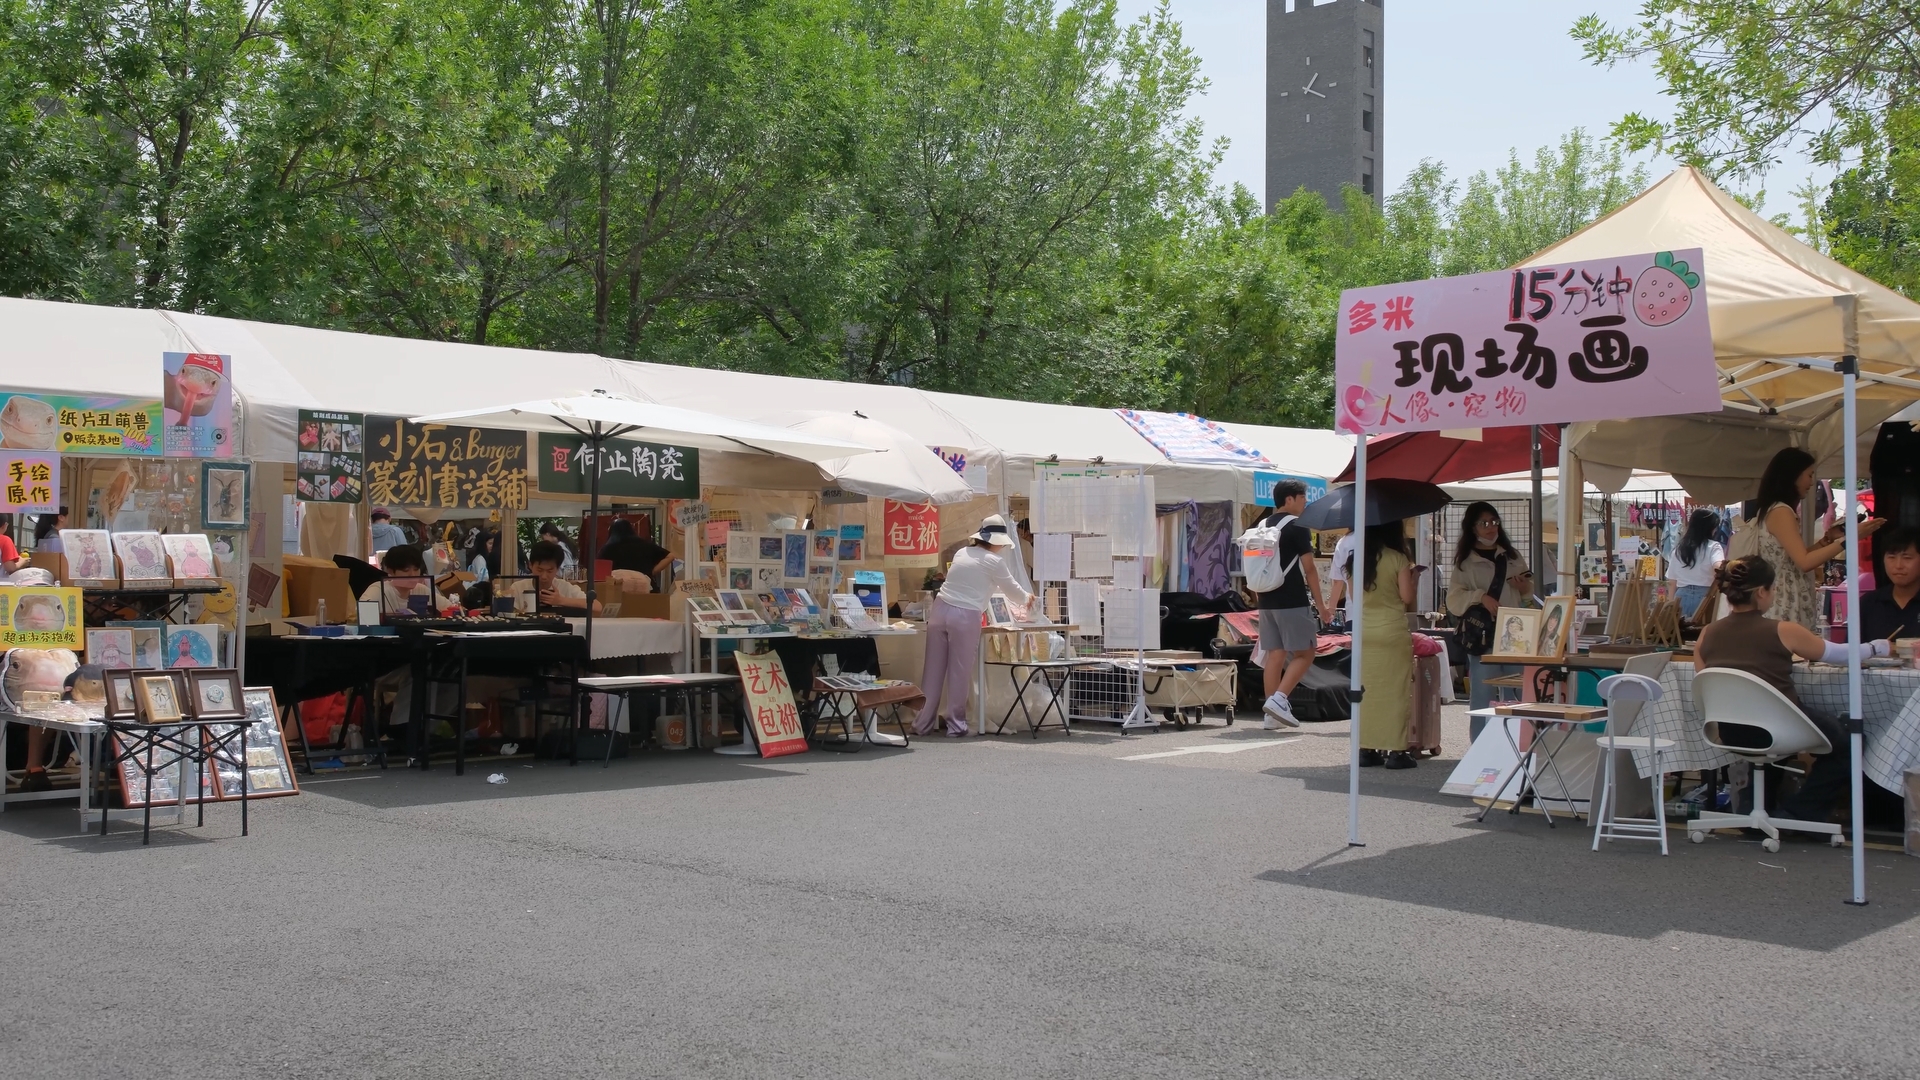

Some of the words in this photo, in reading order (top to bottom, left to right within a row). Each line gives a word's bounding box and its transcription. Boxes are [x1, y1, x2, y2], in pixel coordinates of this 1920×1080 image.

[1508, 265, 1633, 323] 15分钟
[1348, 296, 1415, 335] 多米
[1392, 315, 1649, 396] 现场画
[60, 409, 149, 430] 纸片丑萌兽
[74, 434, 120, 446] 贩卖基地
[378, 418, 447, 461] 小石
[450, 437, 464, 462] &
[465, 428, 523, 476] Burger
[9, 461, 50, 482] 手绘
[573, 442, 685, 482] 何止陶瓷
[7, 485, 50, 504] 原作
[887, 520, 938, 551] 包袱
[743, 661, 788, 695] 艺术
[669, 727, 684, 737] 043
[757, 702, 801, 737] 包袱
